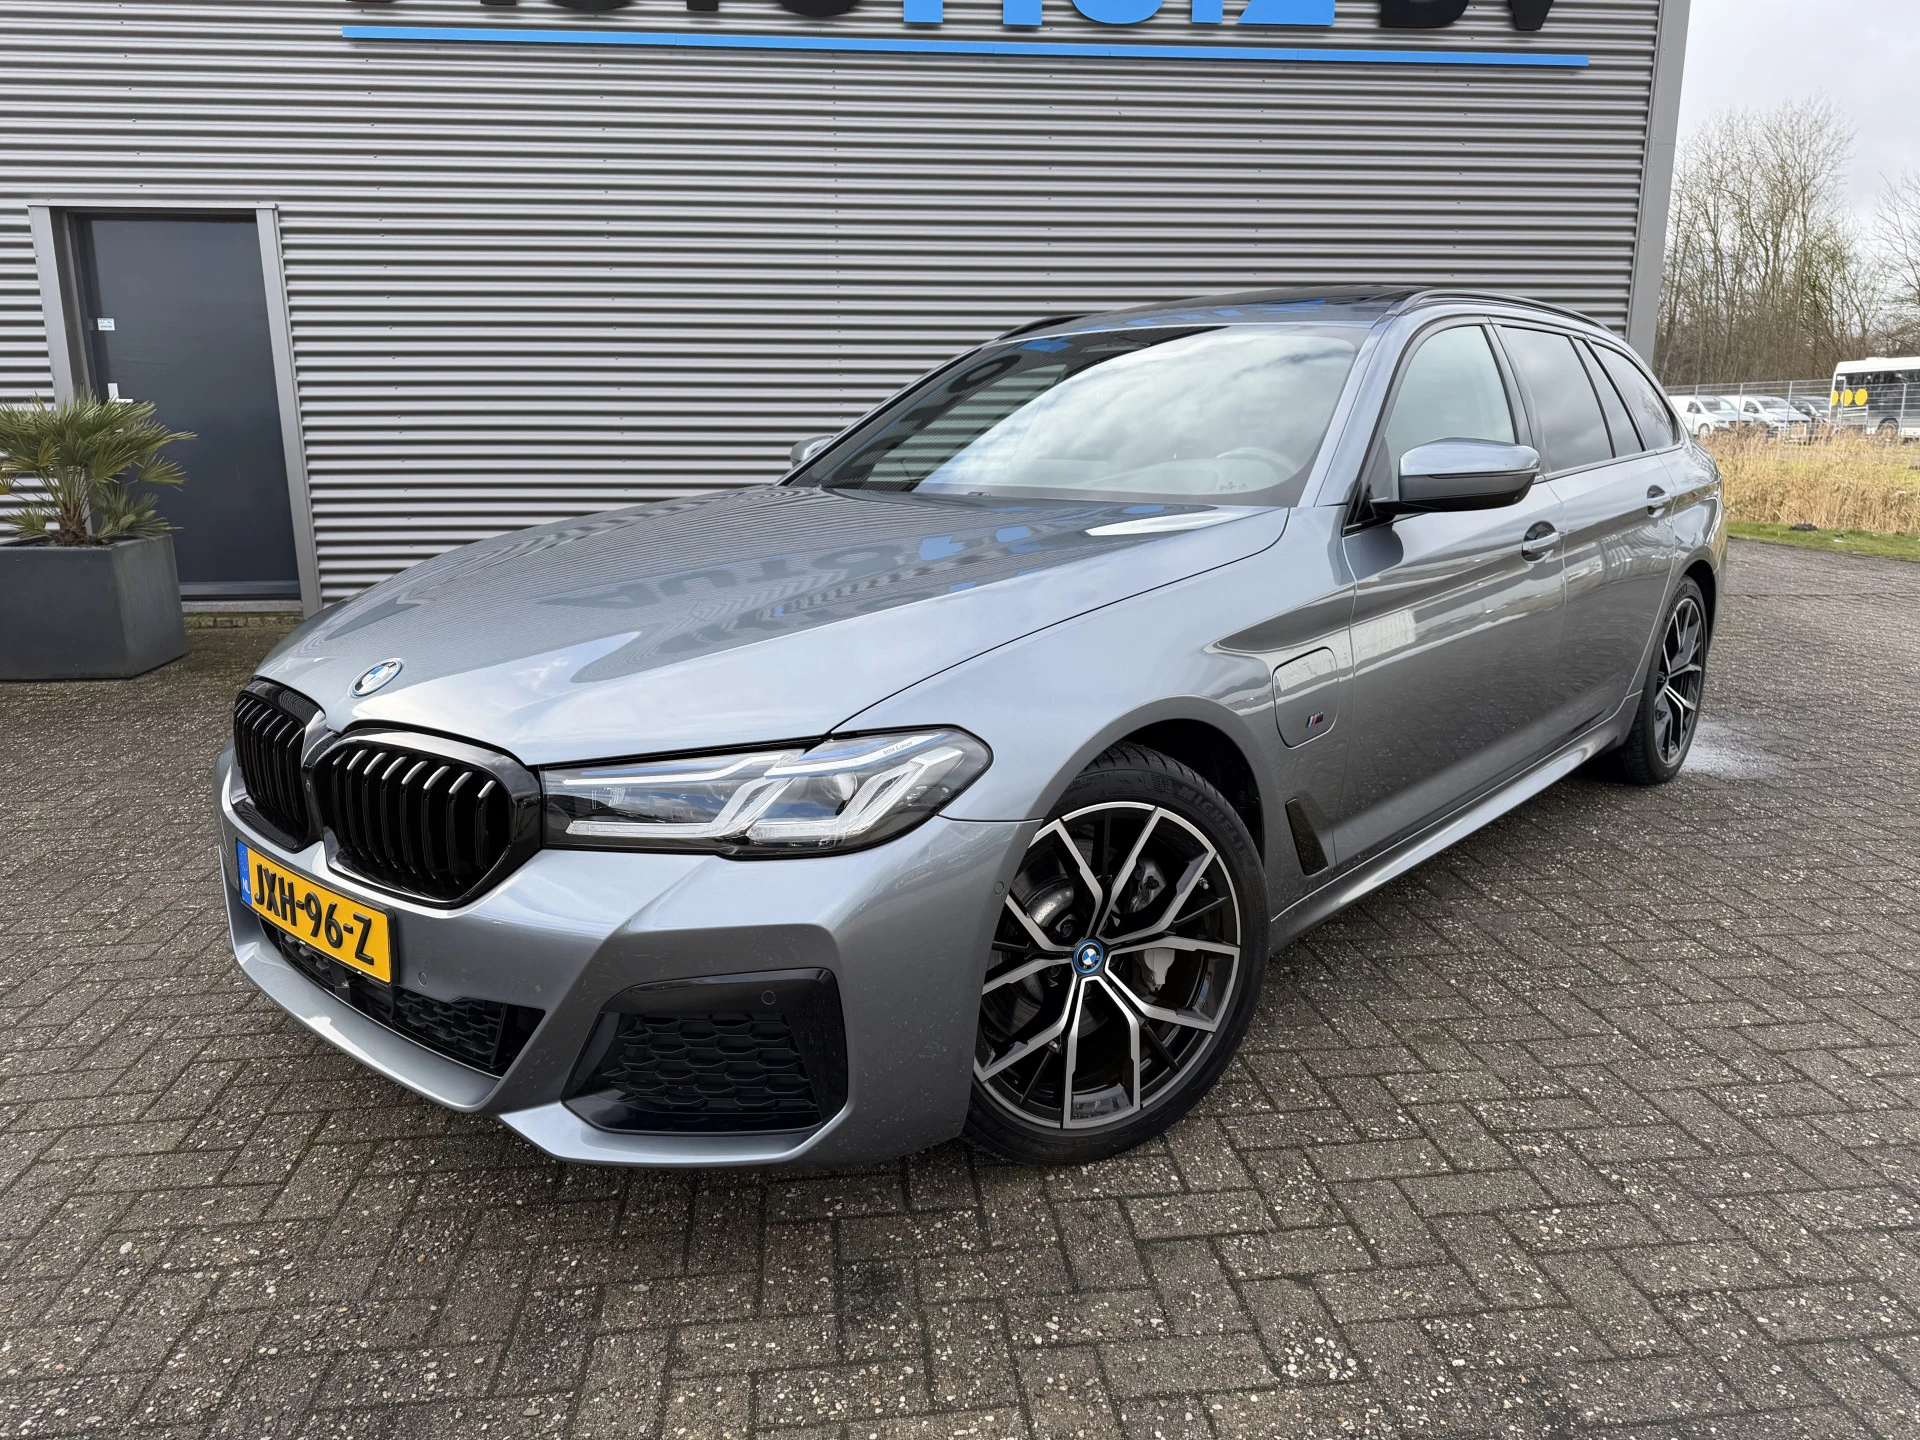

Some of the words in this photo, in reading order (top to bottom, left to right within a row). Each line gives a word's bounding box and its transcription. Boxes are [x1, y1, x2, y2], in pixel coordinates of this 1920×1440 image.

[1177, 785, 1252, 864] MICHELIN
[242, 877, 250, 894] NL
[254, 863, 375, 966] JXH-96-Z
